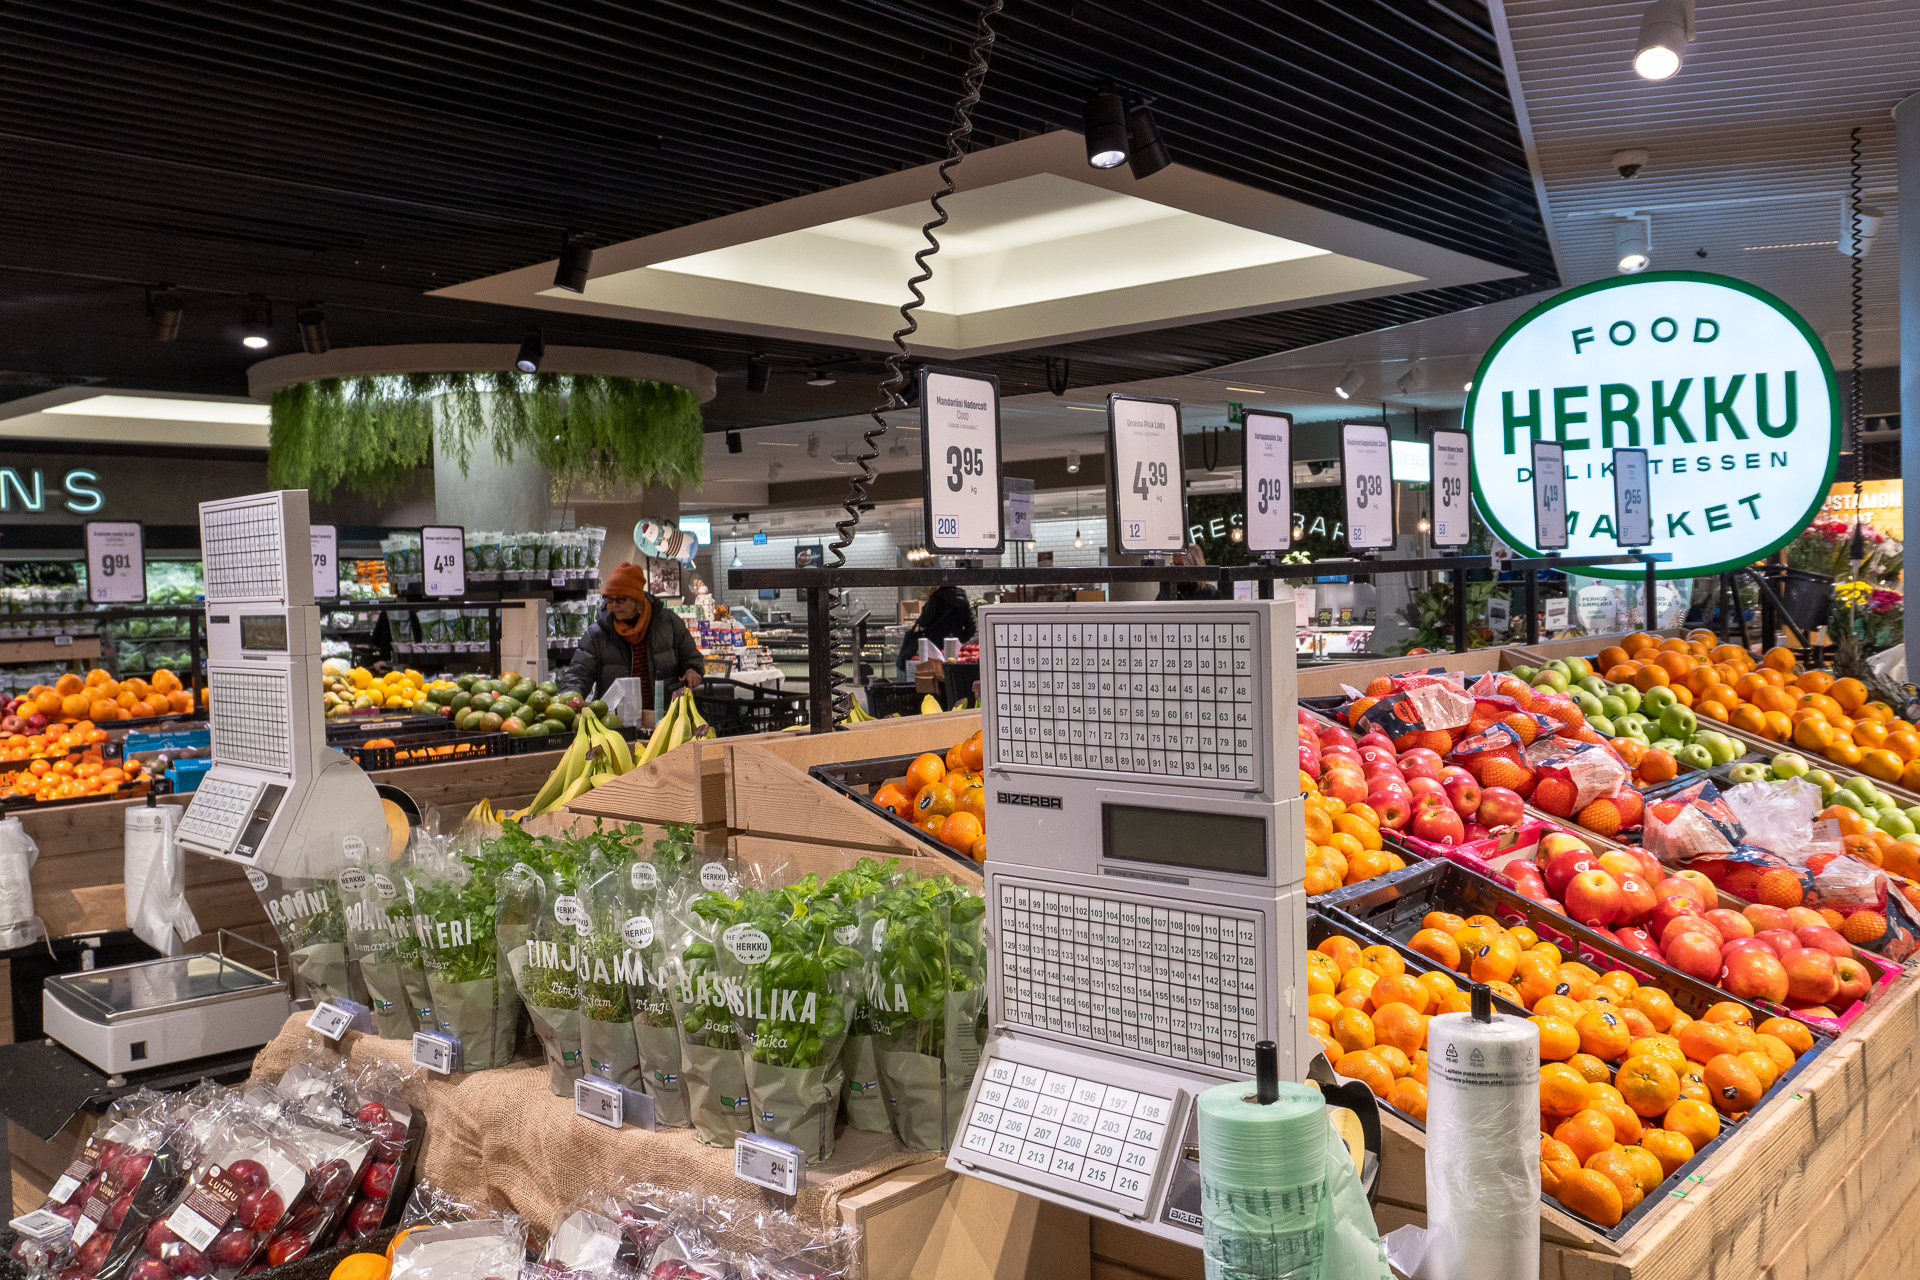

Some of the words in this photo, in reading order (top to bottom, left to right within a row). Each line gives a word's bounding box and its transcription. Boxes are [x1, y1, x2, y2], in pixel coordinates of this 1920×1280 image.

[1572, 316, 1720, 354] FOOD
[1502, 370, 1798, 455] HERKKU
[1518, 451, 1788, 483] DLIKTESSEN
[971, 486, 977, 494] kg
[938, 518, 956, 535] 208
[1129, 524, 1140, 538] 12
[1353, 528, 1362, 541] 52
[1439, 524, 1446, 534] 53
[998, 793, 1062, 809] BIZERBA
[341, 876, 366, 884] HERKKU
[703, 873, 726, 881] HERKKU
[625, 926, 652, 938] HERKKU
[1120, 914, 1134, 923] 105
[1138, 916, 1150, 924] 106
[1170, 921, 1182, 929] 108
[1187, 923, 1199, 932] 109
[1204, 926, 1217, 934] 110
[1222, 929, 1233, 937] 111
[1239, 931, 1252, 940] 112
[736, 943, 768, 951] HERKKU
[993, 1068, 1007, 1079] 193
[1022, 1075, 1035, 1086] 194
[1051, 1082, 1065, 1094] 195
[1079, 1090, 1096, 1102] 196
[1110, 1097, 1127, 1110] 197
[1144, 1105, 1159, 1118] 198
[986, 1090, 1000, 1102] 199
[1013, 1097, 1029, 1109] 200
[1041, 1105, 1058, 1117] 201
[1072, 1112, 1089, 1125] 202
[1101, 1120, 1120, 1133] 203
[1133, 1128, 1152, 1142] 204
[977, 1111, 994, 1124] 205
[1005, 1119, 1022, 1132] 206
[1034, 1127, 1051, 1140] 207
[1064, 1135, 1081, 1148] 208
[1094, 1143, 1112, 1157] 209
[1126, 1152, 1145, 1166] 210
[970, 1134, 986, 1147] 211
[998, 1142, 1015, 1155] 212
[1026, 1150, 1044, 1164] 213
[1056, 1158, 1074, 1172] 214
[1087, 1167, 1106, 1182] 215
[1119, 1176, 1138, 1191] 216
[208, 1178, 238, 1201] LUUMU
